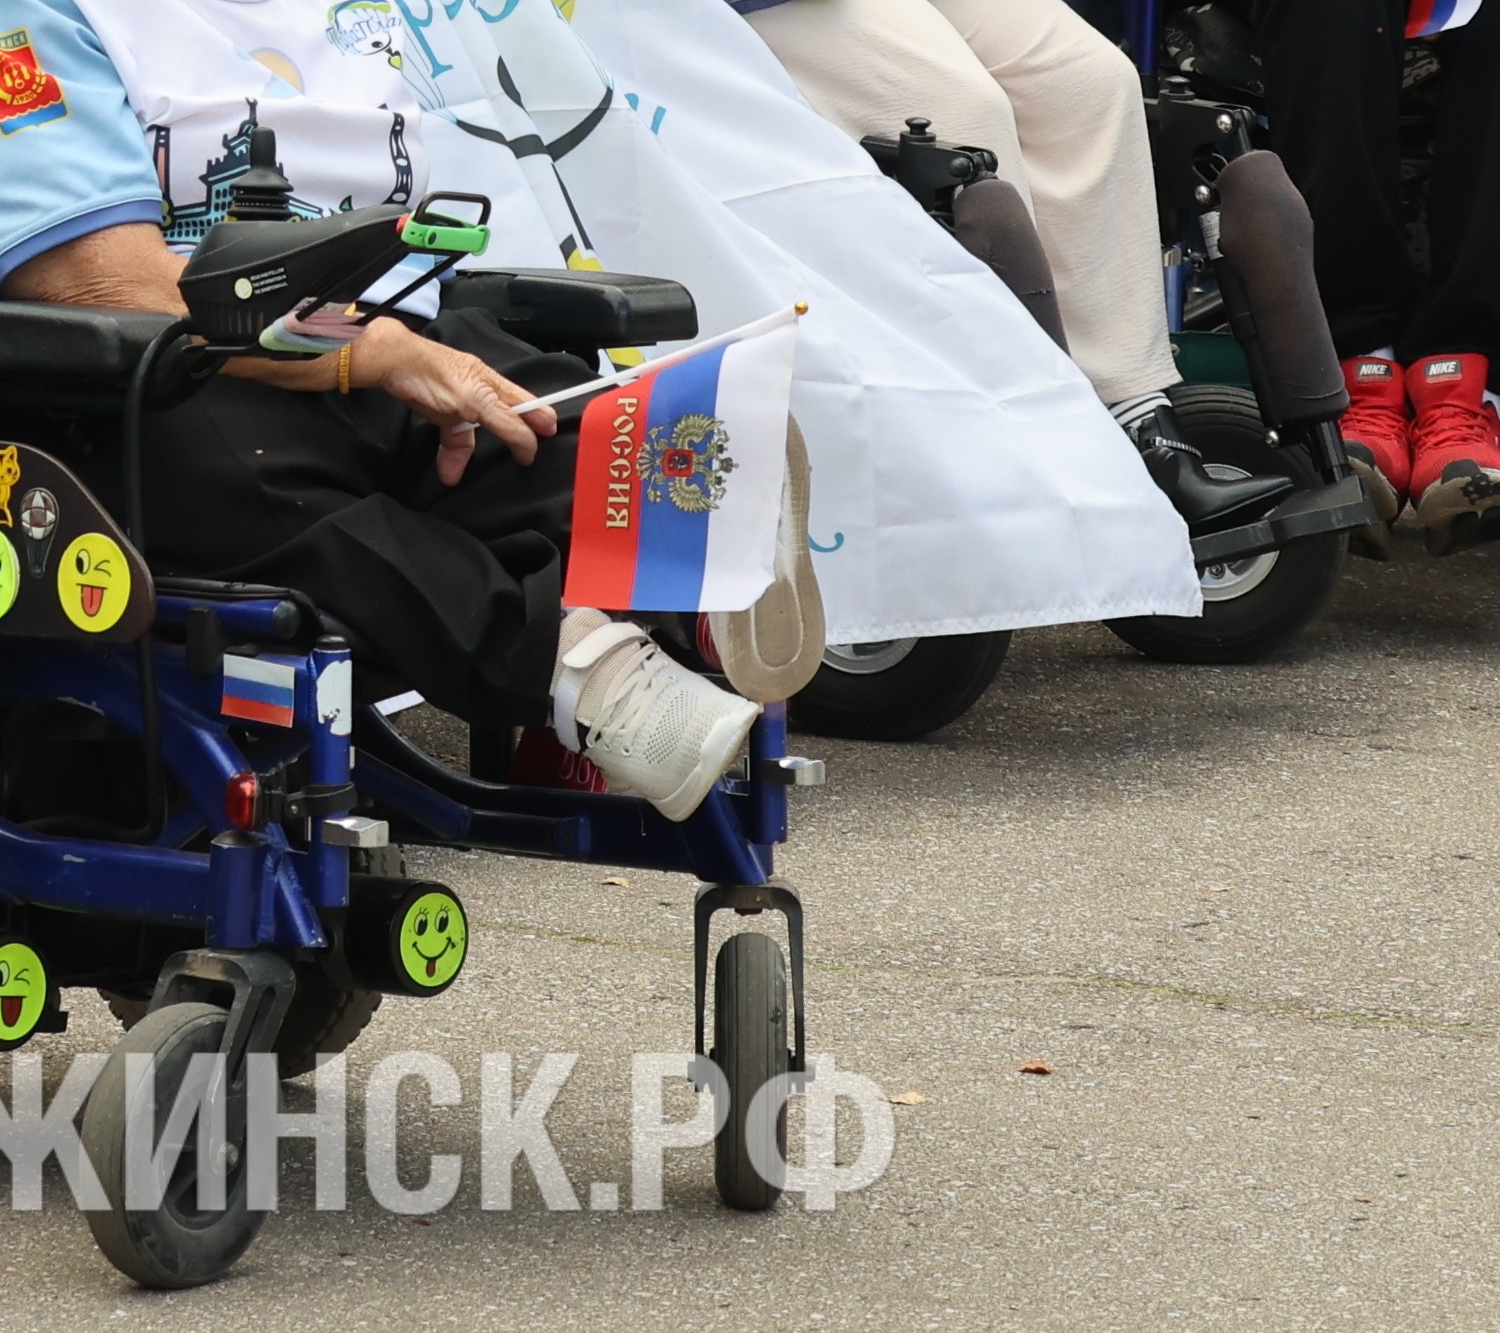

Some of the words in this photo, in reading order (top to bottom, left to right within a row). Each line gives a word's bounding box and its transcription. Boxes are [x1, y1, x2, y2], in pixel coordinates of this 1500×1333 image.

[1359, 364, 1388, 376] NIKE
[1429, 361, 1457, 375] NIKE
[607, 397, 638, 530] РОССИЯ
